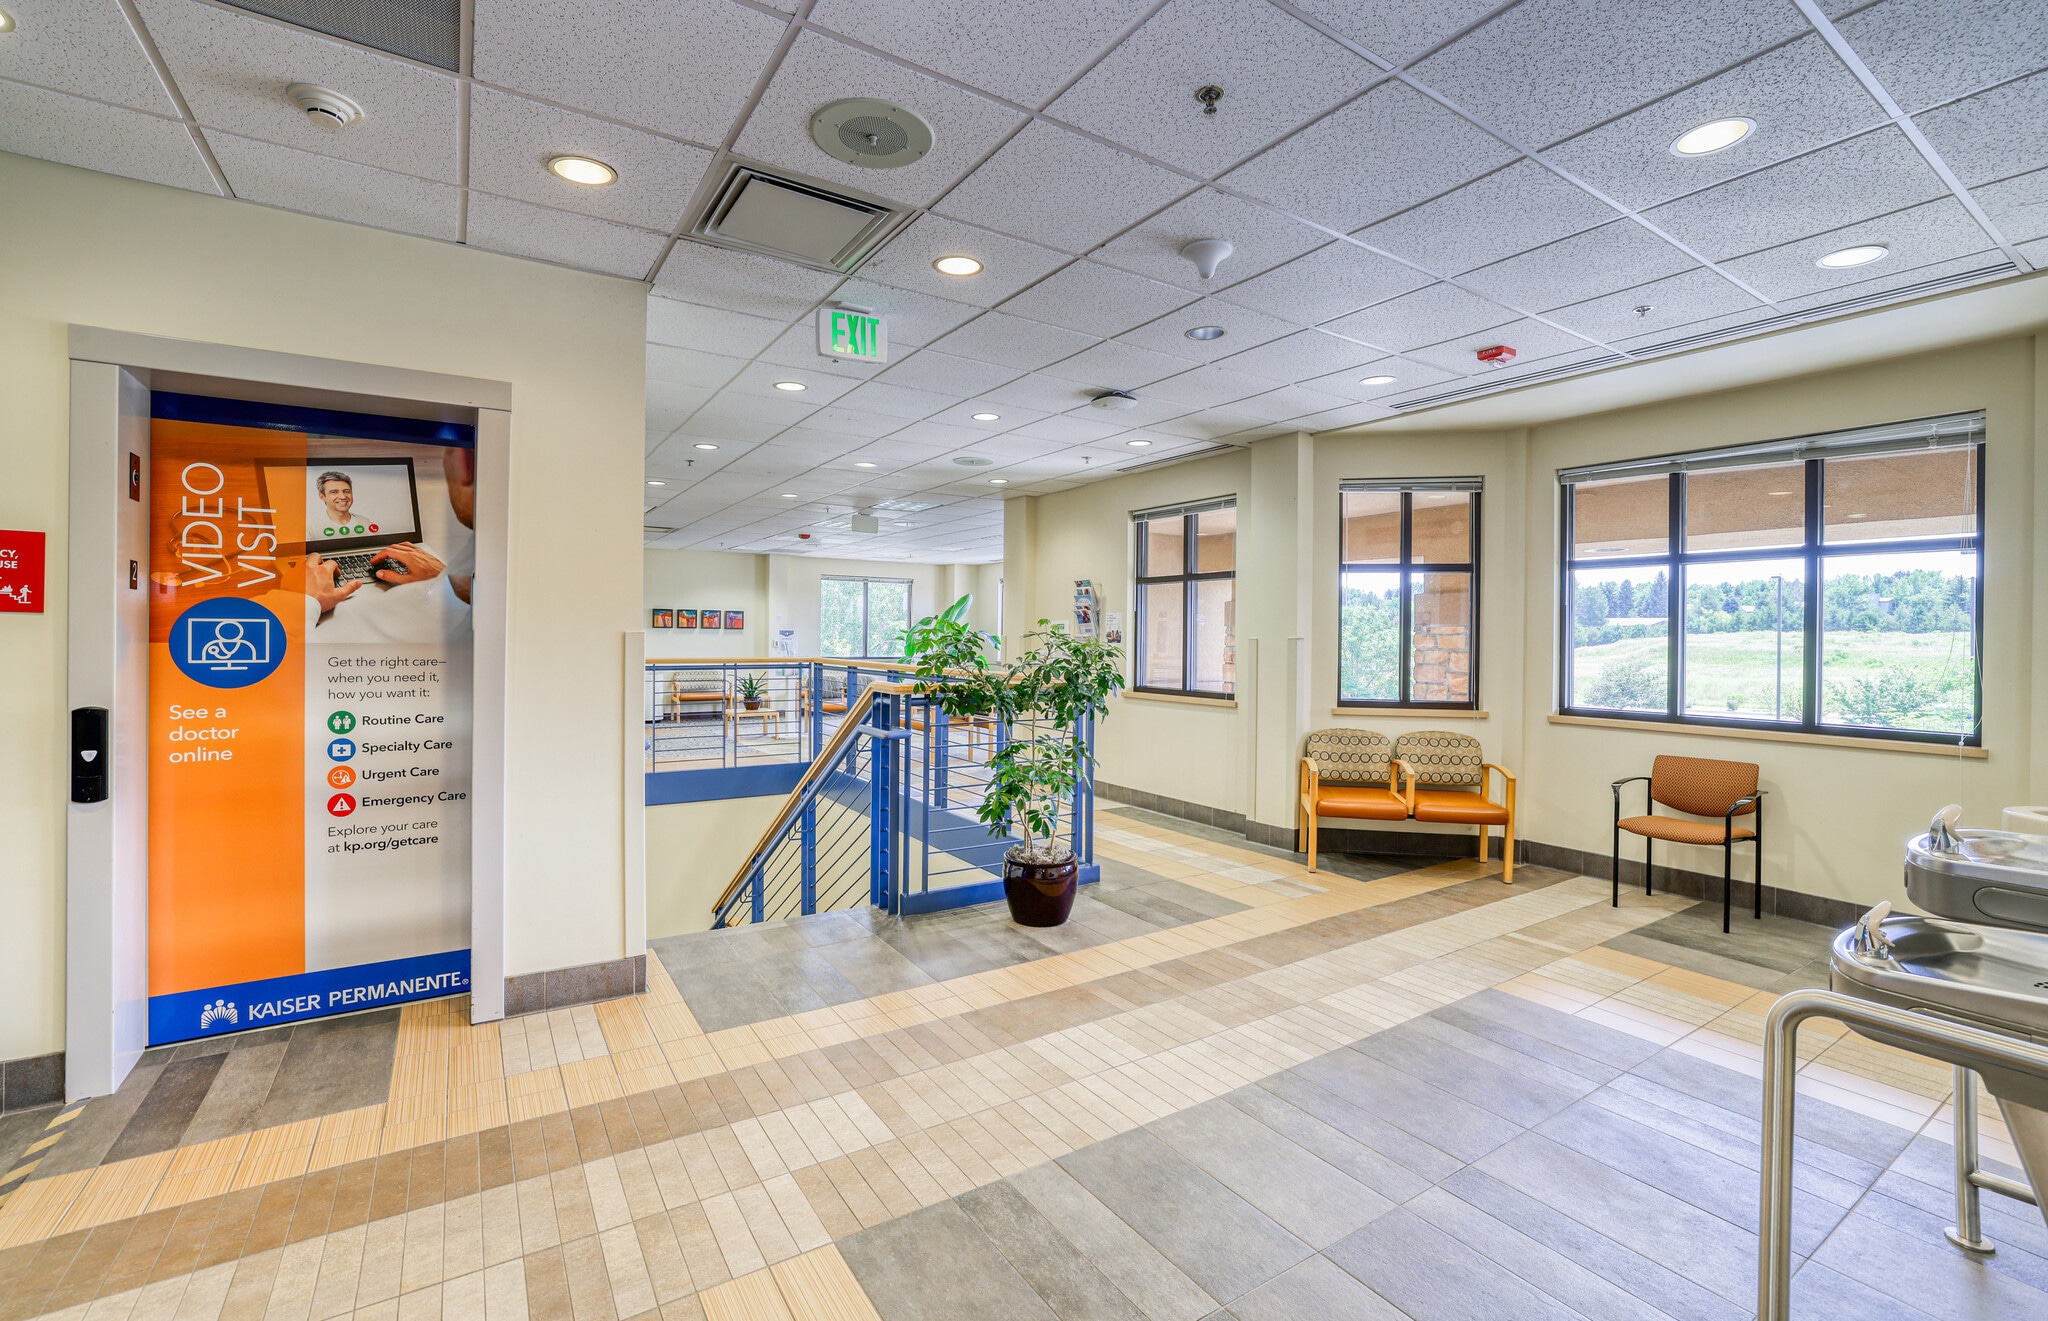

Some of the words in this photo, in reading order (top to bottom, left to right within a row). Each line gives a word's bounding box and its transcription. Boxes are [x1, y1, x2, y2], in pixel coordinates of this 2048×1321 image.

[831, 311, 880, 357] EXIT
[181, 462, 225, 588] VIDEO
[236, 496, 278, 589] VISIT
[132, 562, 138, 581] 2
[327, 656, 352, 668] Get
[355, 656, 377, 668] the
[380, 656, 409, 670] right
[327, 672, 363, 684] when
[366, 674, 391, 686] you
[394, 672, 426, 683] need
[429, 672, 441, 684] it,
[327, 688, 356, 700] how
[359, 690, 383, 702] you
[386, 688, 416, 699] want
[419, 688, 430, 699] it:
[168, 704, 209, 720] See
[214, 707, 227, 719] a
[361, 715, 412, 726] Routine
[414, 713, 445, 725] Care
[168, 726, 240, 743] doctor
[168, 747, 233, 764] online
[361, 740, 421, 755] Specialty
[423, 739, 453, 751] Care
[361, 769, 407, 783] Urgent
[409, 766, 440, 778] Care
[361, 794, 435, 809] Emergency
[437, 791, 467, 803] Care
[327, 825, 378, 839] Explore
[380, 823, 409, 837] your
[411, 819, 439, 831] care
[327, 844, 341, 854] at
[343, 836, 439, 853] kp.org/getcare
[248, 994, 321, 1022] KAISER
